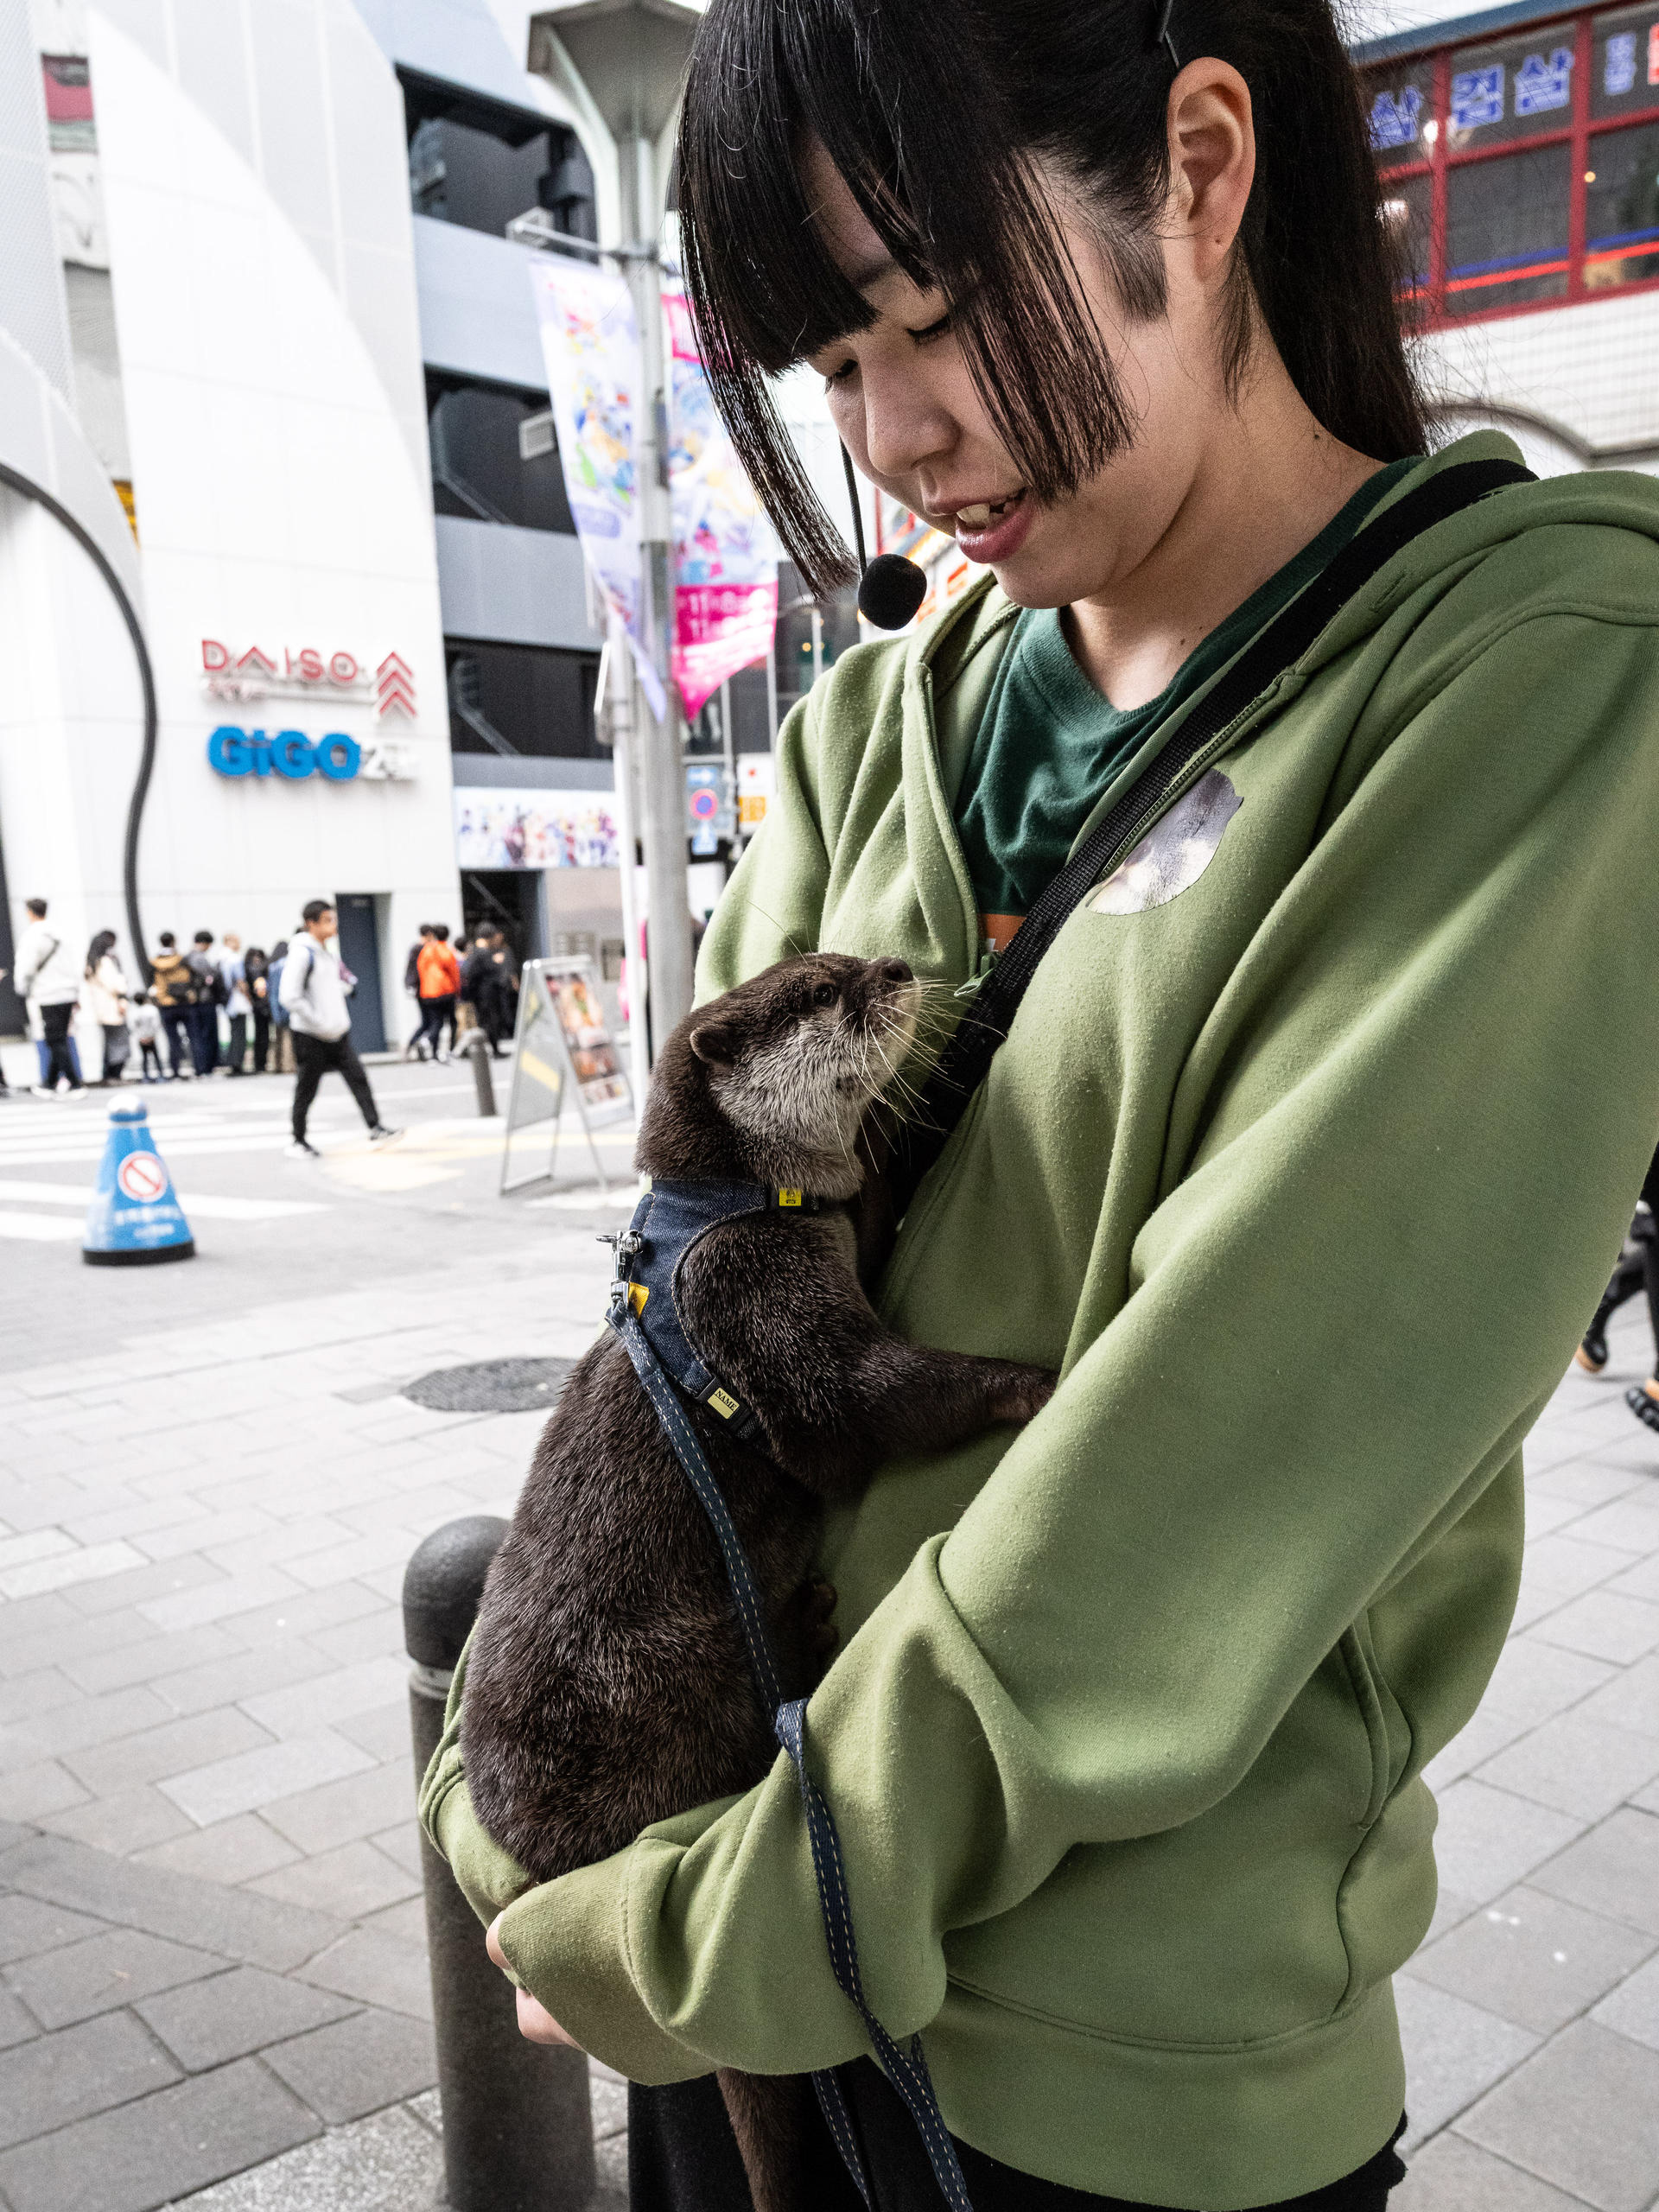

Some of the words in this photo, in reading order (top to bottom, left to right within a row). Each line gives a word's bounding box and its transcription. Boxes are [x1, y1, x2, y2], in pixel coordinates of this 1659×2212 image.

[201, 639, 358, 682] DAISO
[207, 725, 361, 779] GiGO
[715, 1389, 737, 1411] NAME
